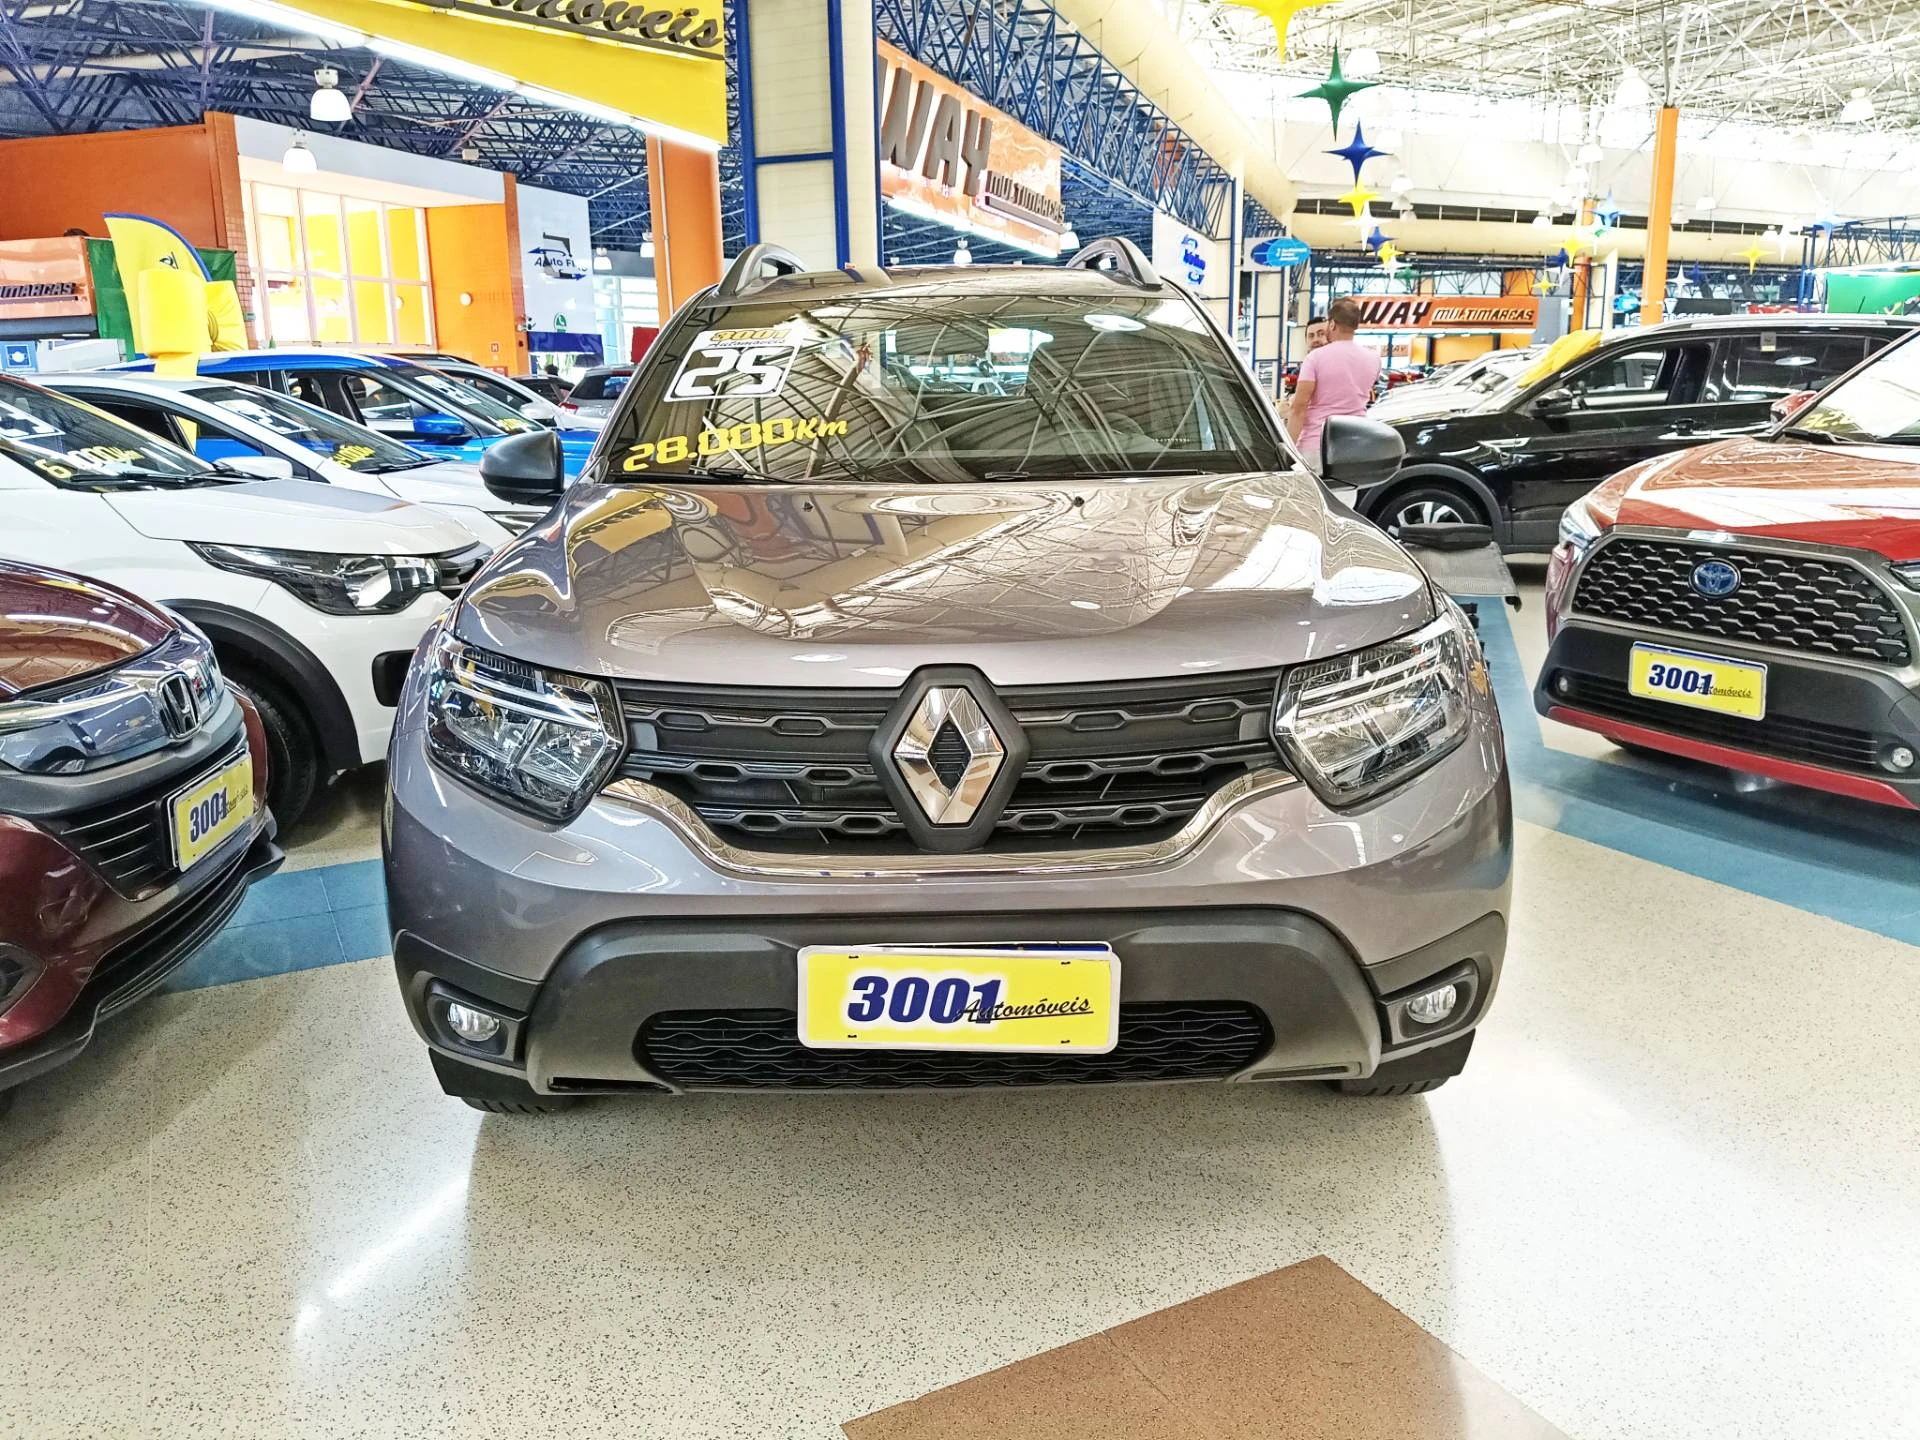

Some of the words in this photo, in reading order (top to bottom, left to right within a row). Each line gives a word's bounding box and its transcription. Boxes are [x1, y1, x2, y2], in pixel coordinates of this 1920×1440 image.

[877, 56, 993, 197] WAY
[985, 171, 1066, 224] MULTIMARCAS
[1360, 301, 1433, 324] WAY
[1433, 307, 1535, 321] MULTIMARCAS
[673, 347, 795, 396] 25
[1648, 664, 1713, 696] 3001
[190, 787, 227, 843] 3001
[848, 976, 1002, 1024] 3001
[952, 997, 1091, 1023] Automóveis
